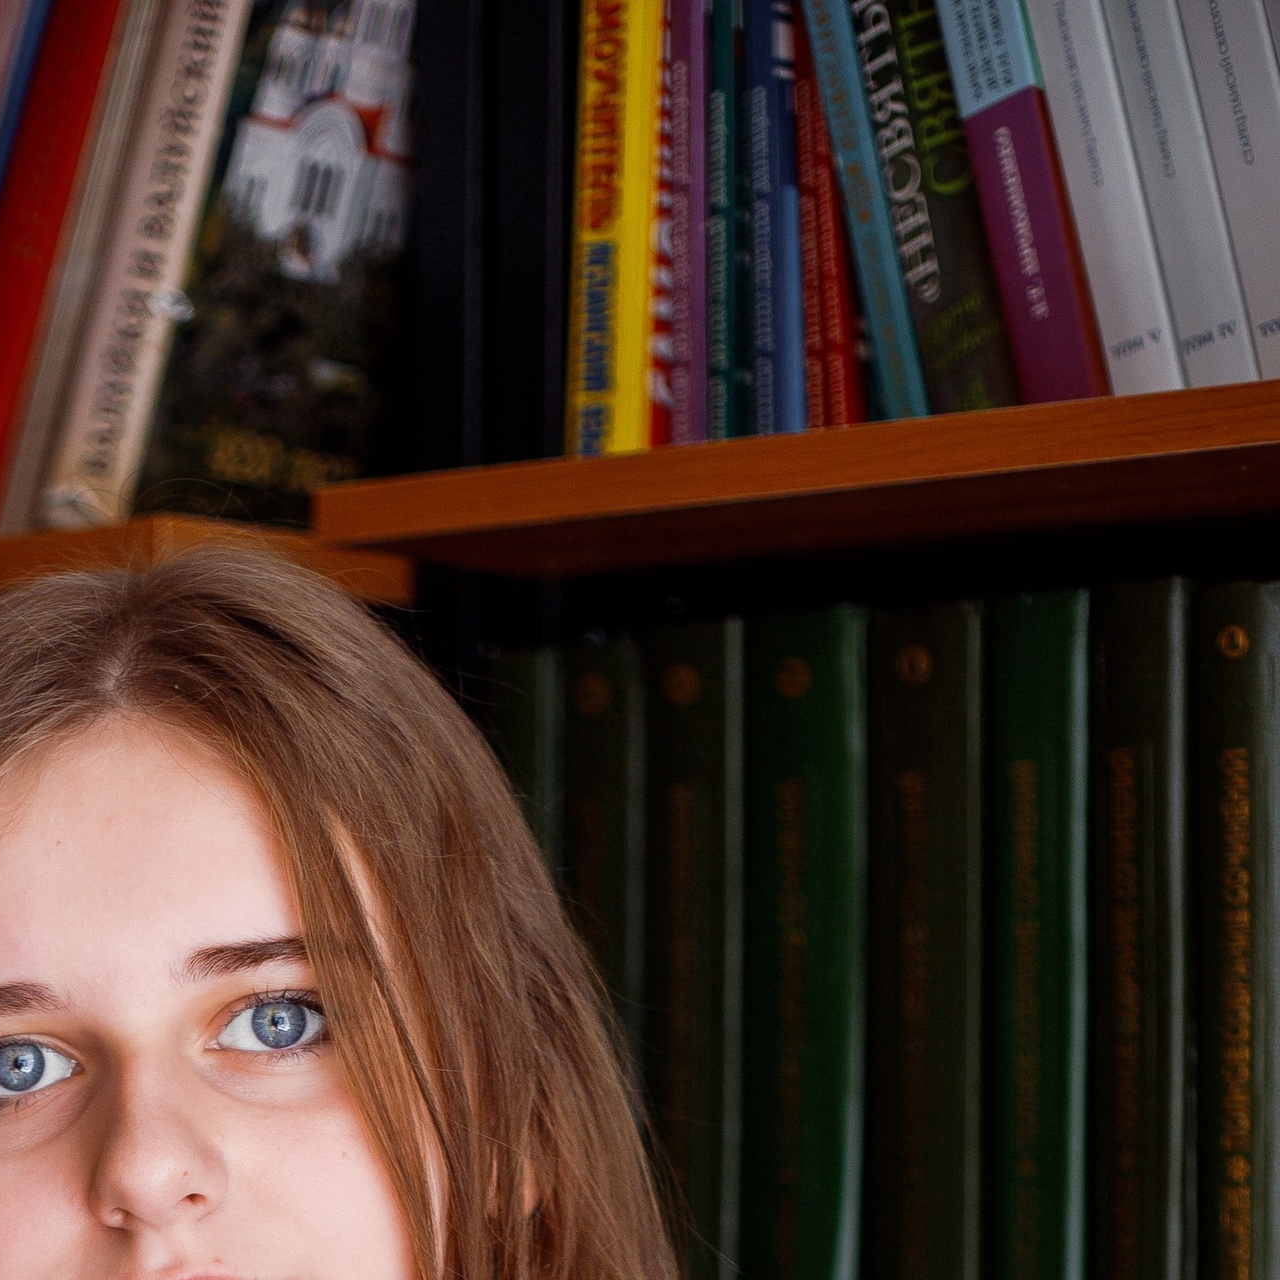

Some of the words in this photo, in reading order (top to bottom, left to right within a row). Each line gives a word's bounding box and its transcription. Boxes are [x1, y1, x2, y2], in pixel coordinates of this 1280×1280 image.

[124, 246, 165, 283] И
[1220, 746, 1250, 904] СОЧИНЕНИЙ
[1220, 909, 1250, 1041] СОБРАНИЕ
[1220, 1045, 1250, 1151] ПОЛНОЕ
